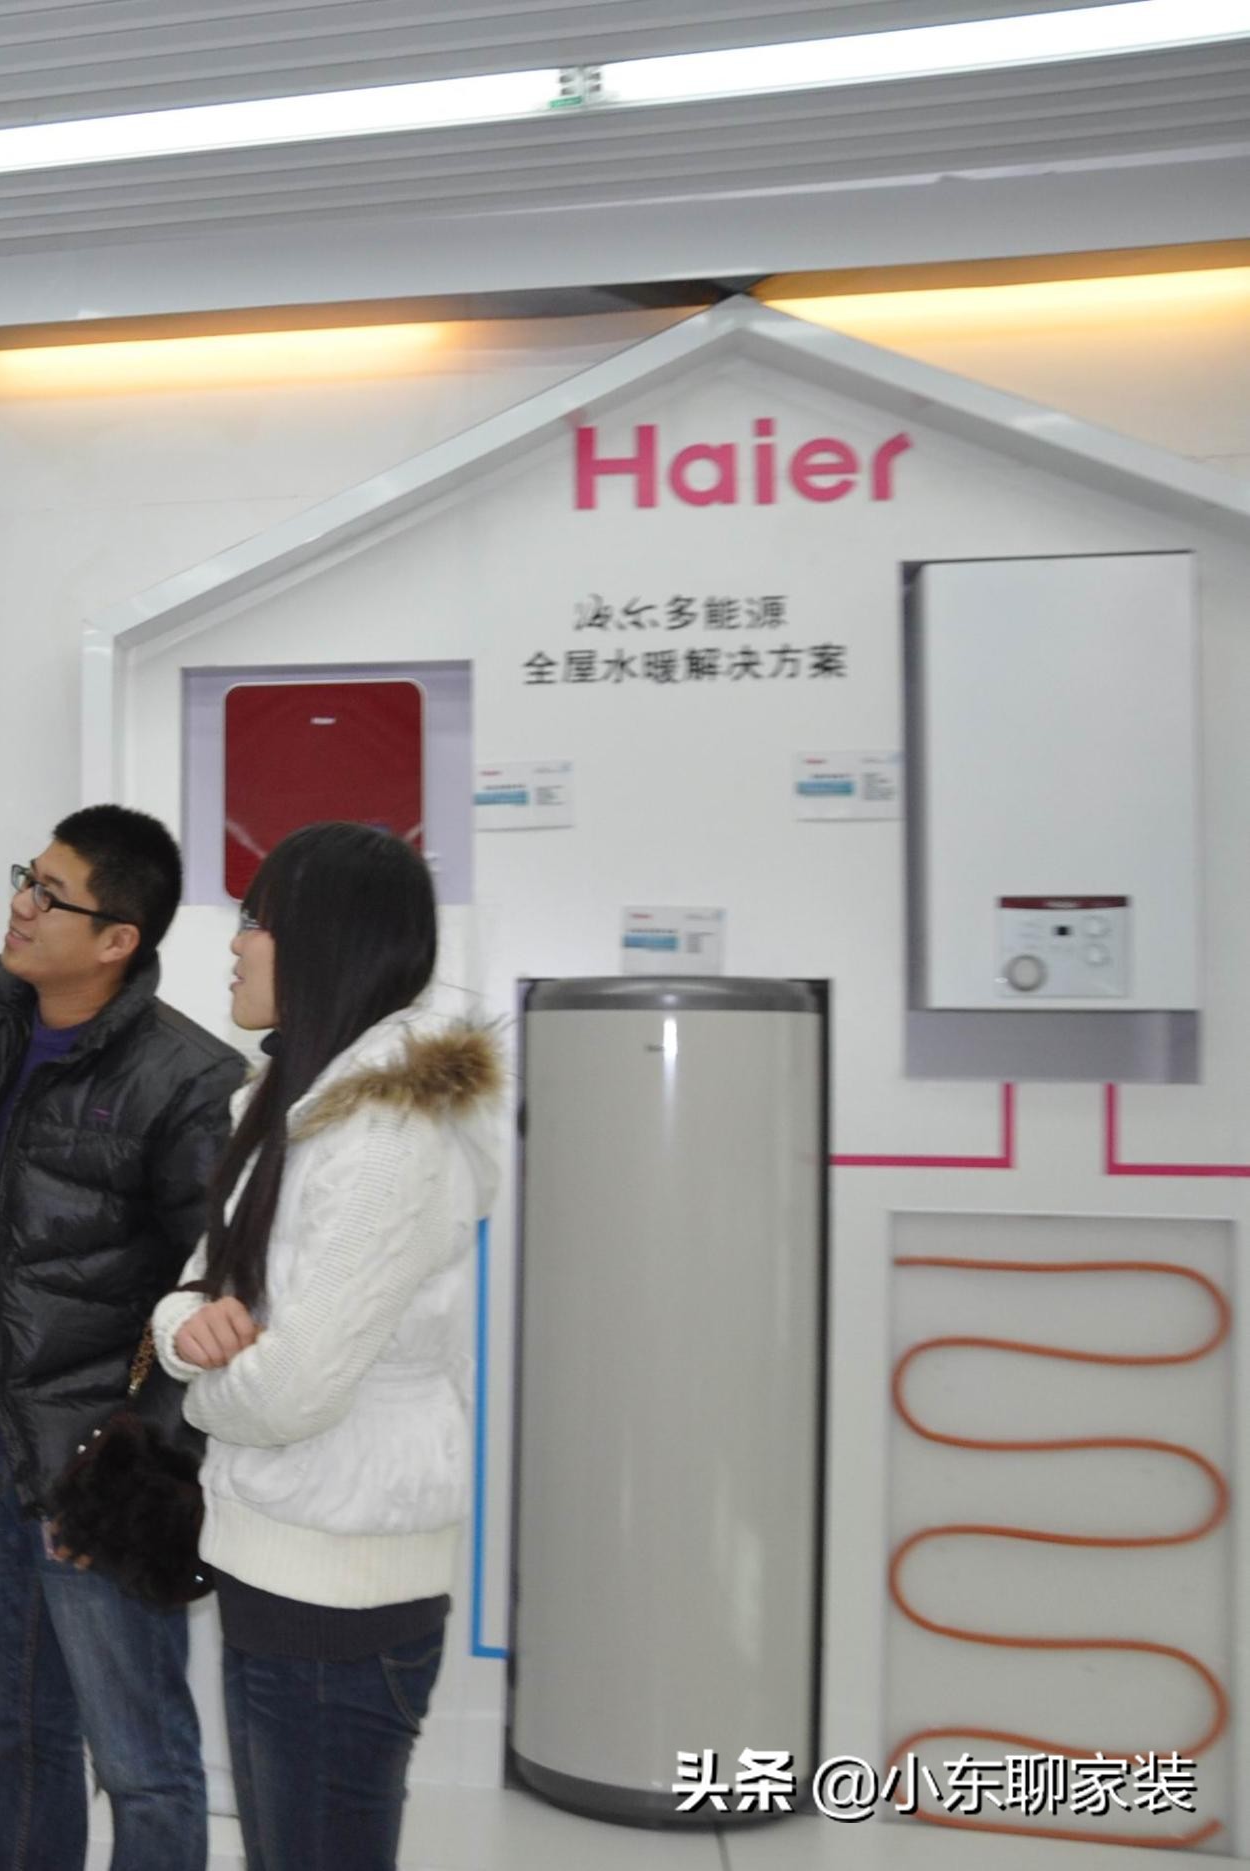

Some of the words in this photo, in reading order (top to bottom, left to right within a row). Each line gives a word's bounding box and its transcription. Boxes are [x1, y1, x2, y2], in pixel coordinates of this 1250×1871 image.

[573, 418, 913, 511] Haier
[572, 593, 789, 632] 海尔多能源
[523, 643, 848, 686] 全屋水暖解决方案
